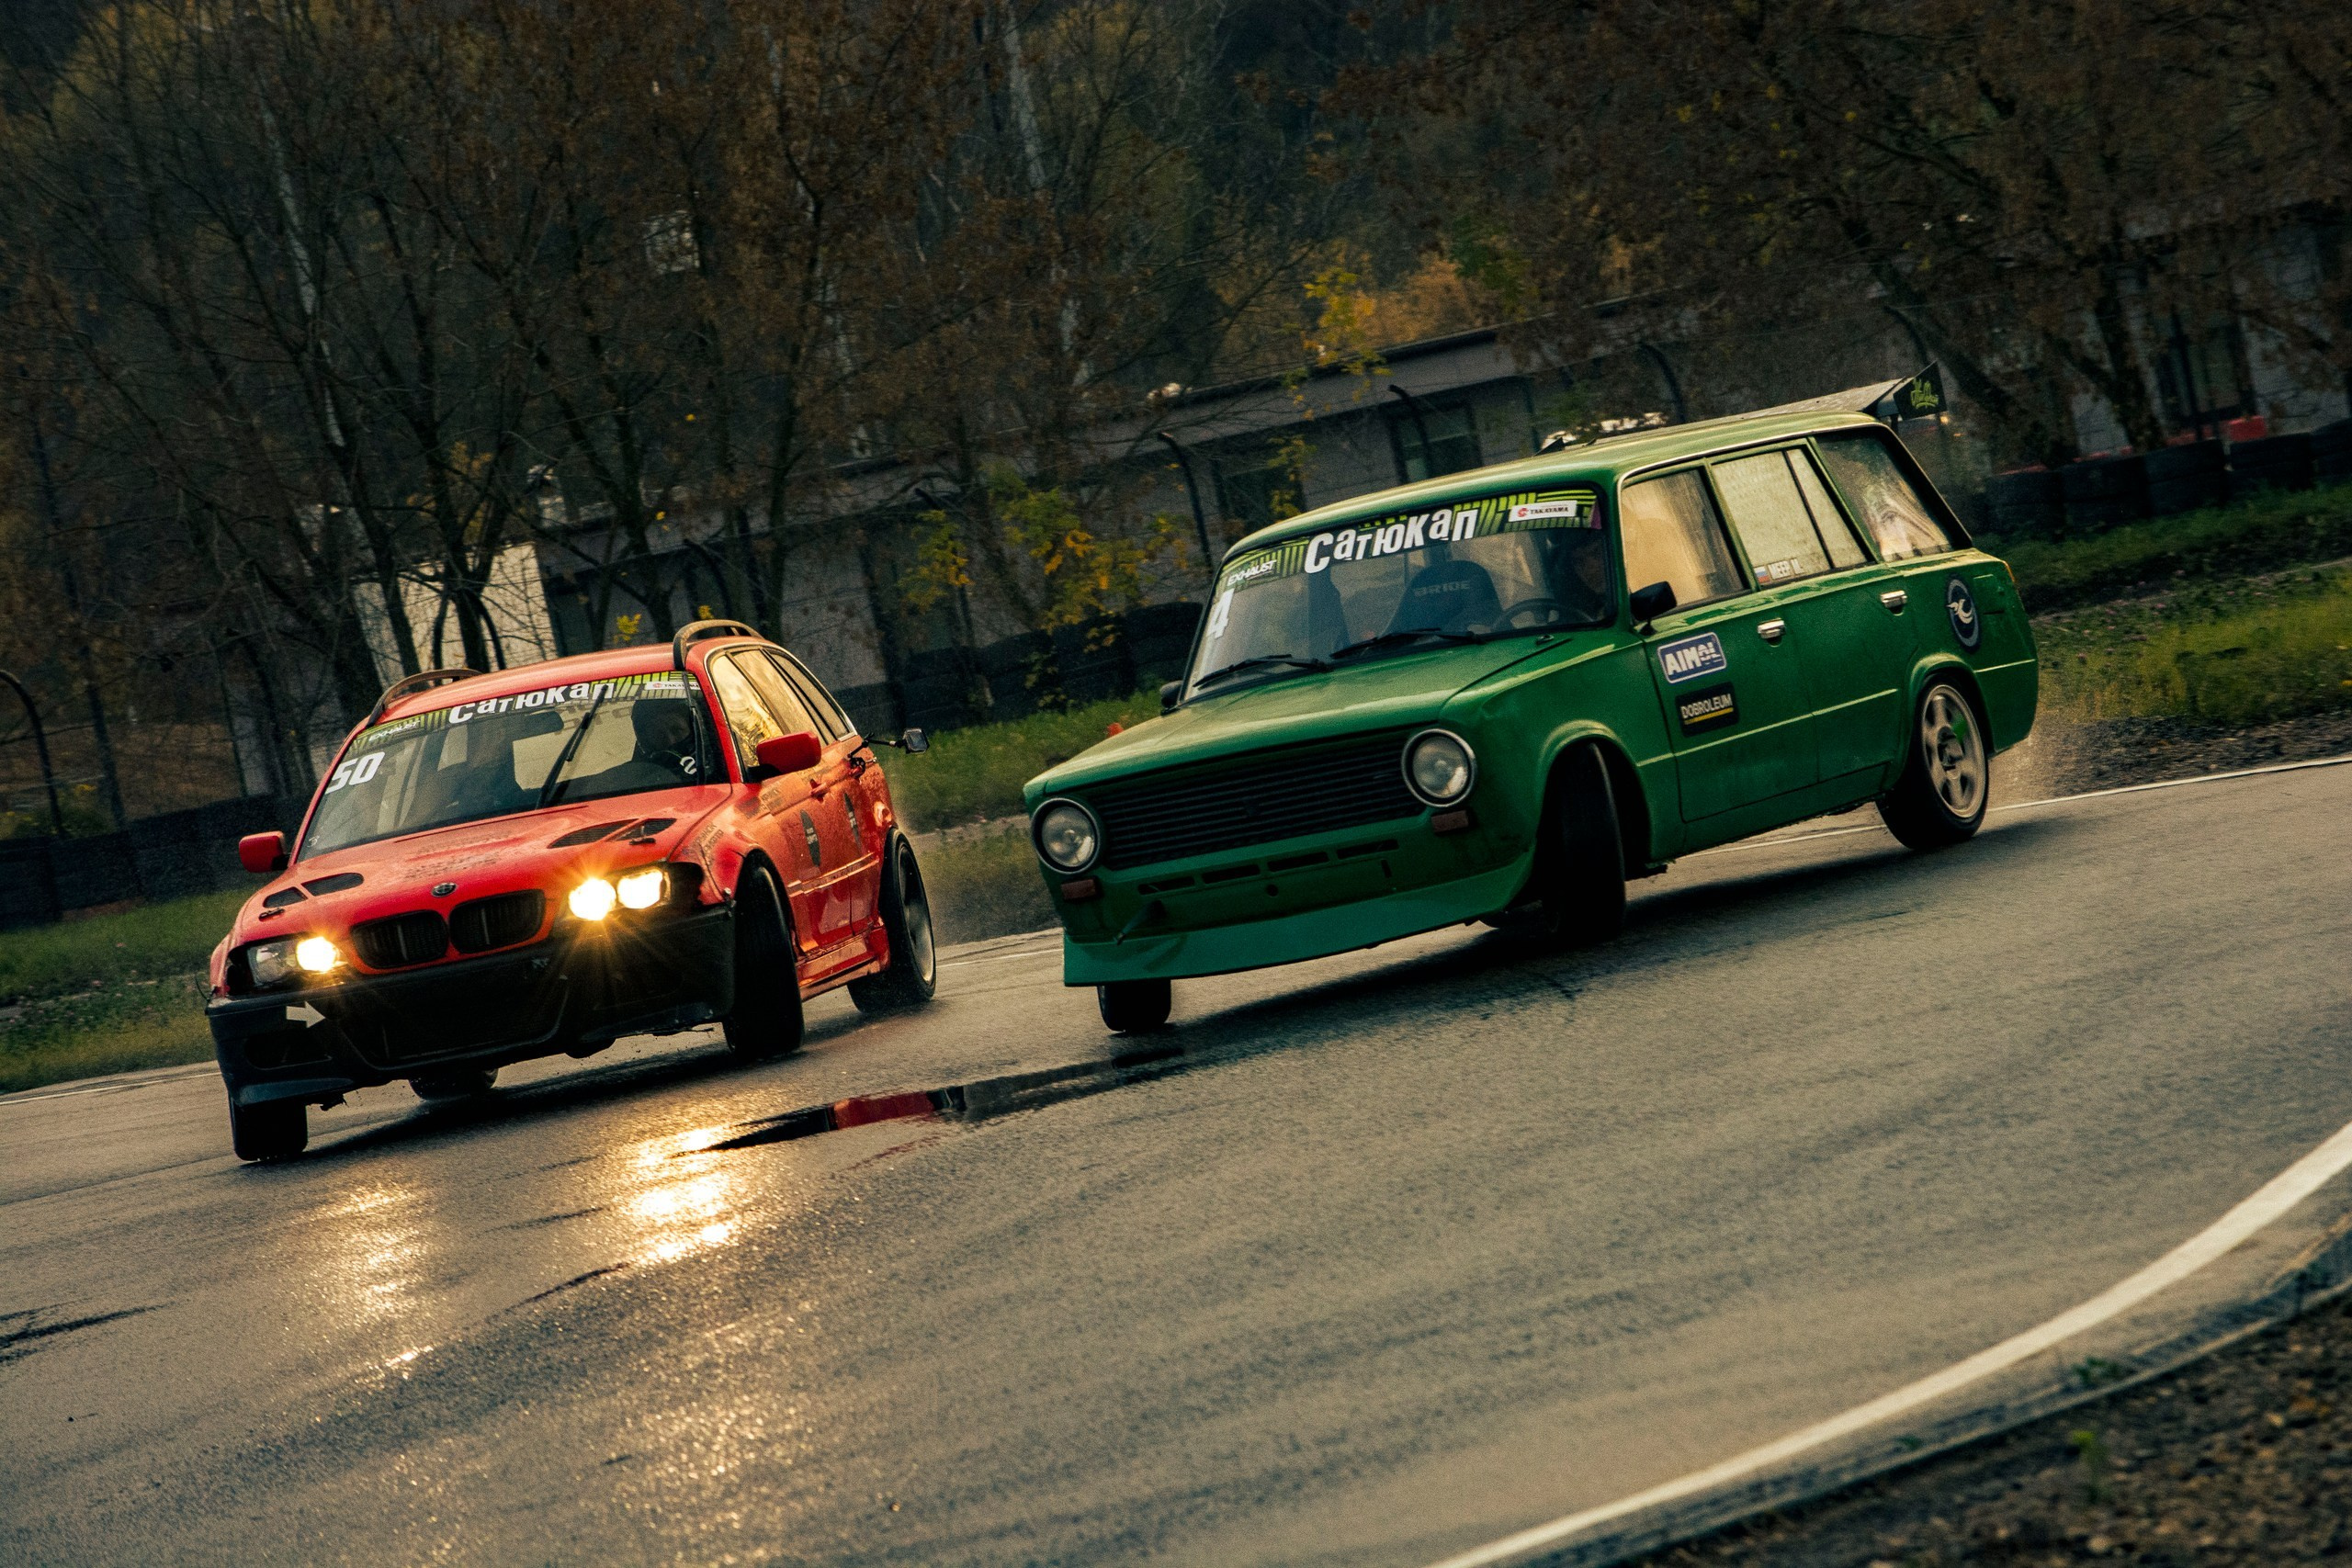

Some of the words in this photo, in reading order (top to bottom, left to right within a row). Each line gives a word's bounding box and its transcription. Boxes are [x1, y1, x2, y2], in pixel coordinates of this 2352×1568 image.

[1531, 506, 1568, 514] TAKAYAMA
[1227, 559, 1277, 586] EXHAUST
[1205, 588, 1235, 639] 4
[1665, 642, 1721, 675] AIMOL
[1680, 694, 1734, 718] DOBROLEUM
[324, 751, 386, 795] 50
